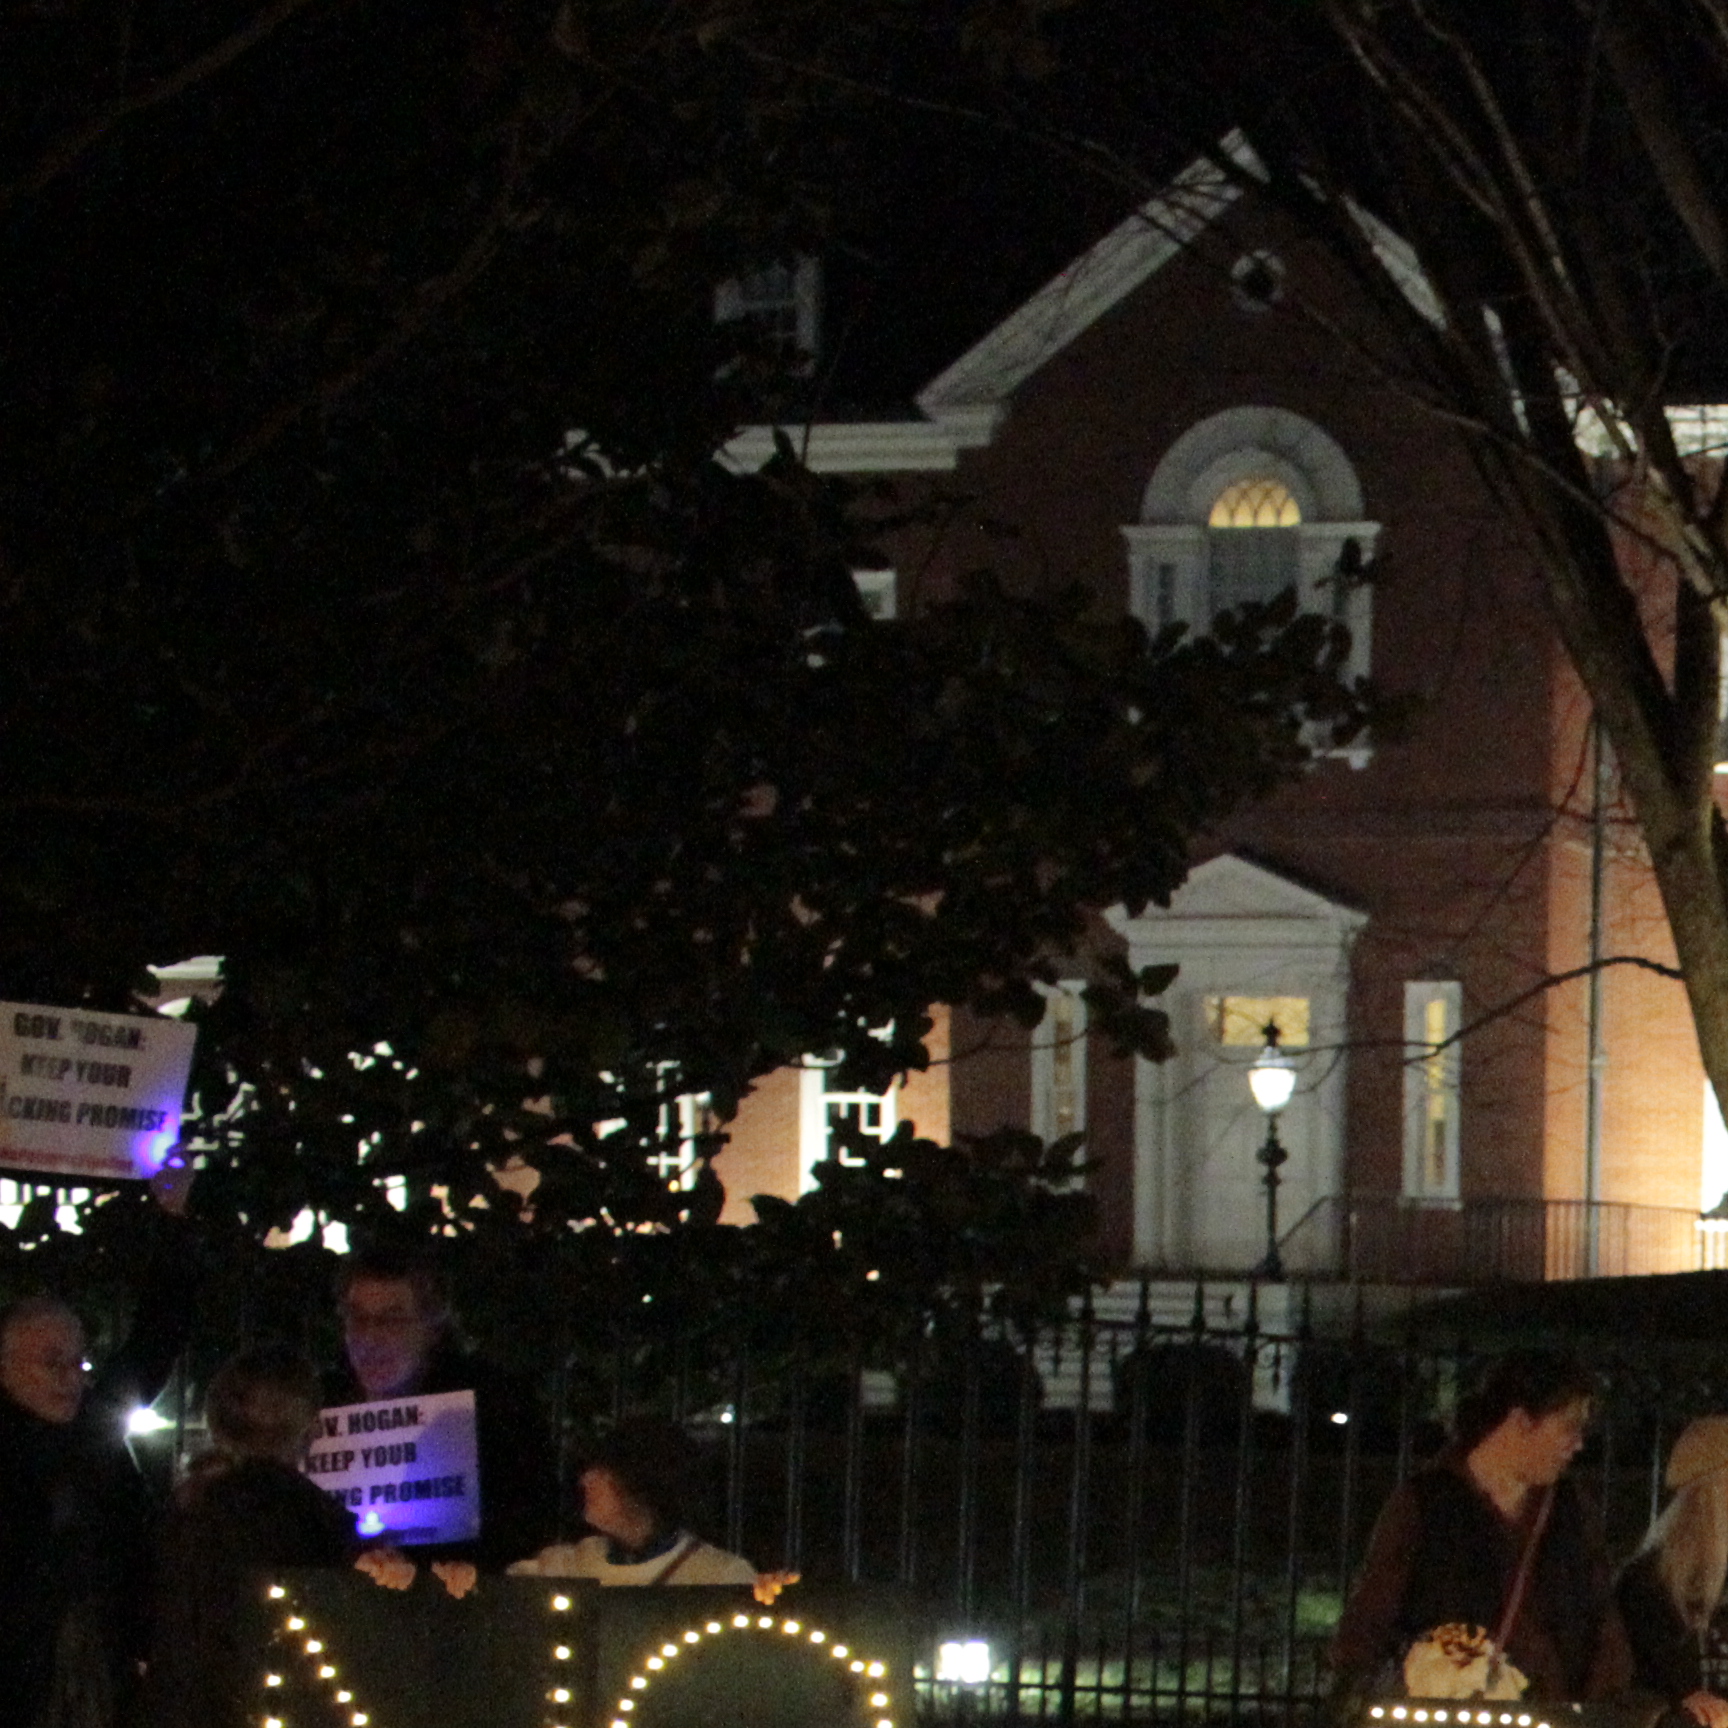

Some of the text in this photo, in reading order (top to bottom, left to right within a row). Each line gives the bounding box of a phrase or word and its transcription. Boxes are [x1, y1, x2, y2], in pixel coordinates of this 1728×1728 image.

[75, 1059, 132, 1088] YOUR
[361, 1442, 417, 1468] YOUR
[369, 1475, 465, 1505] PROMISE
